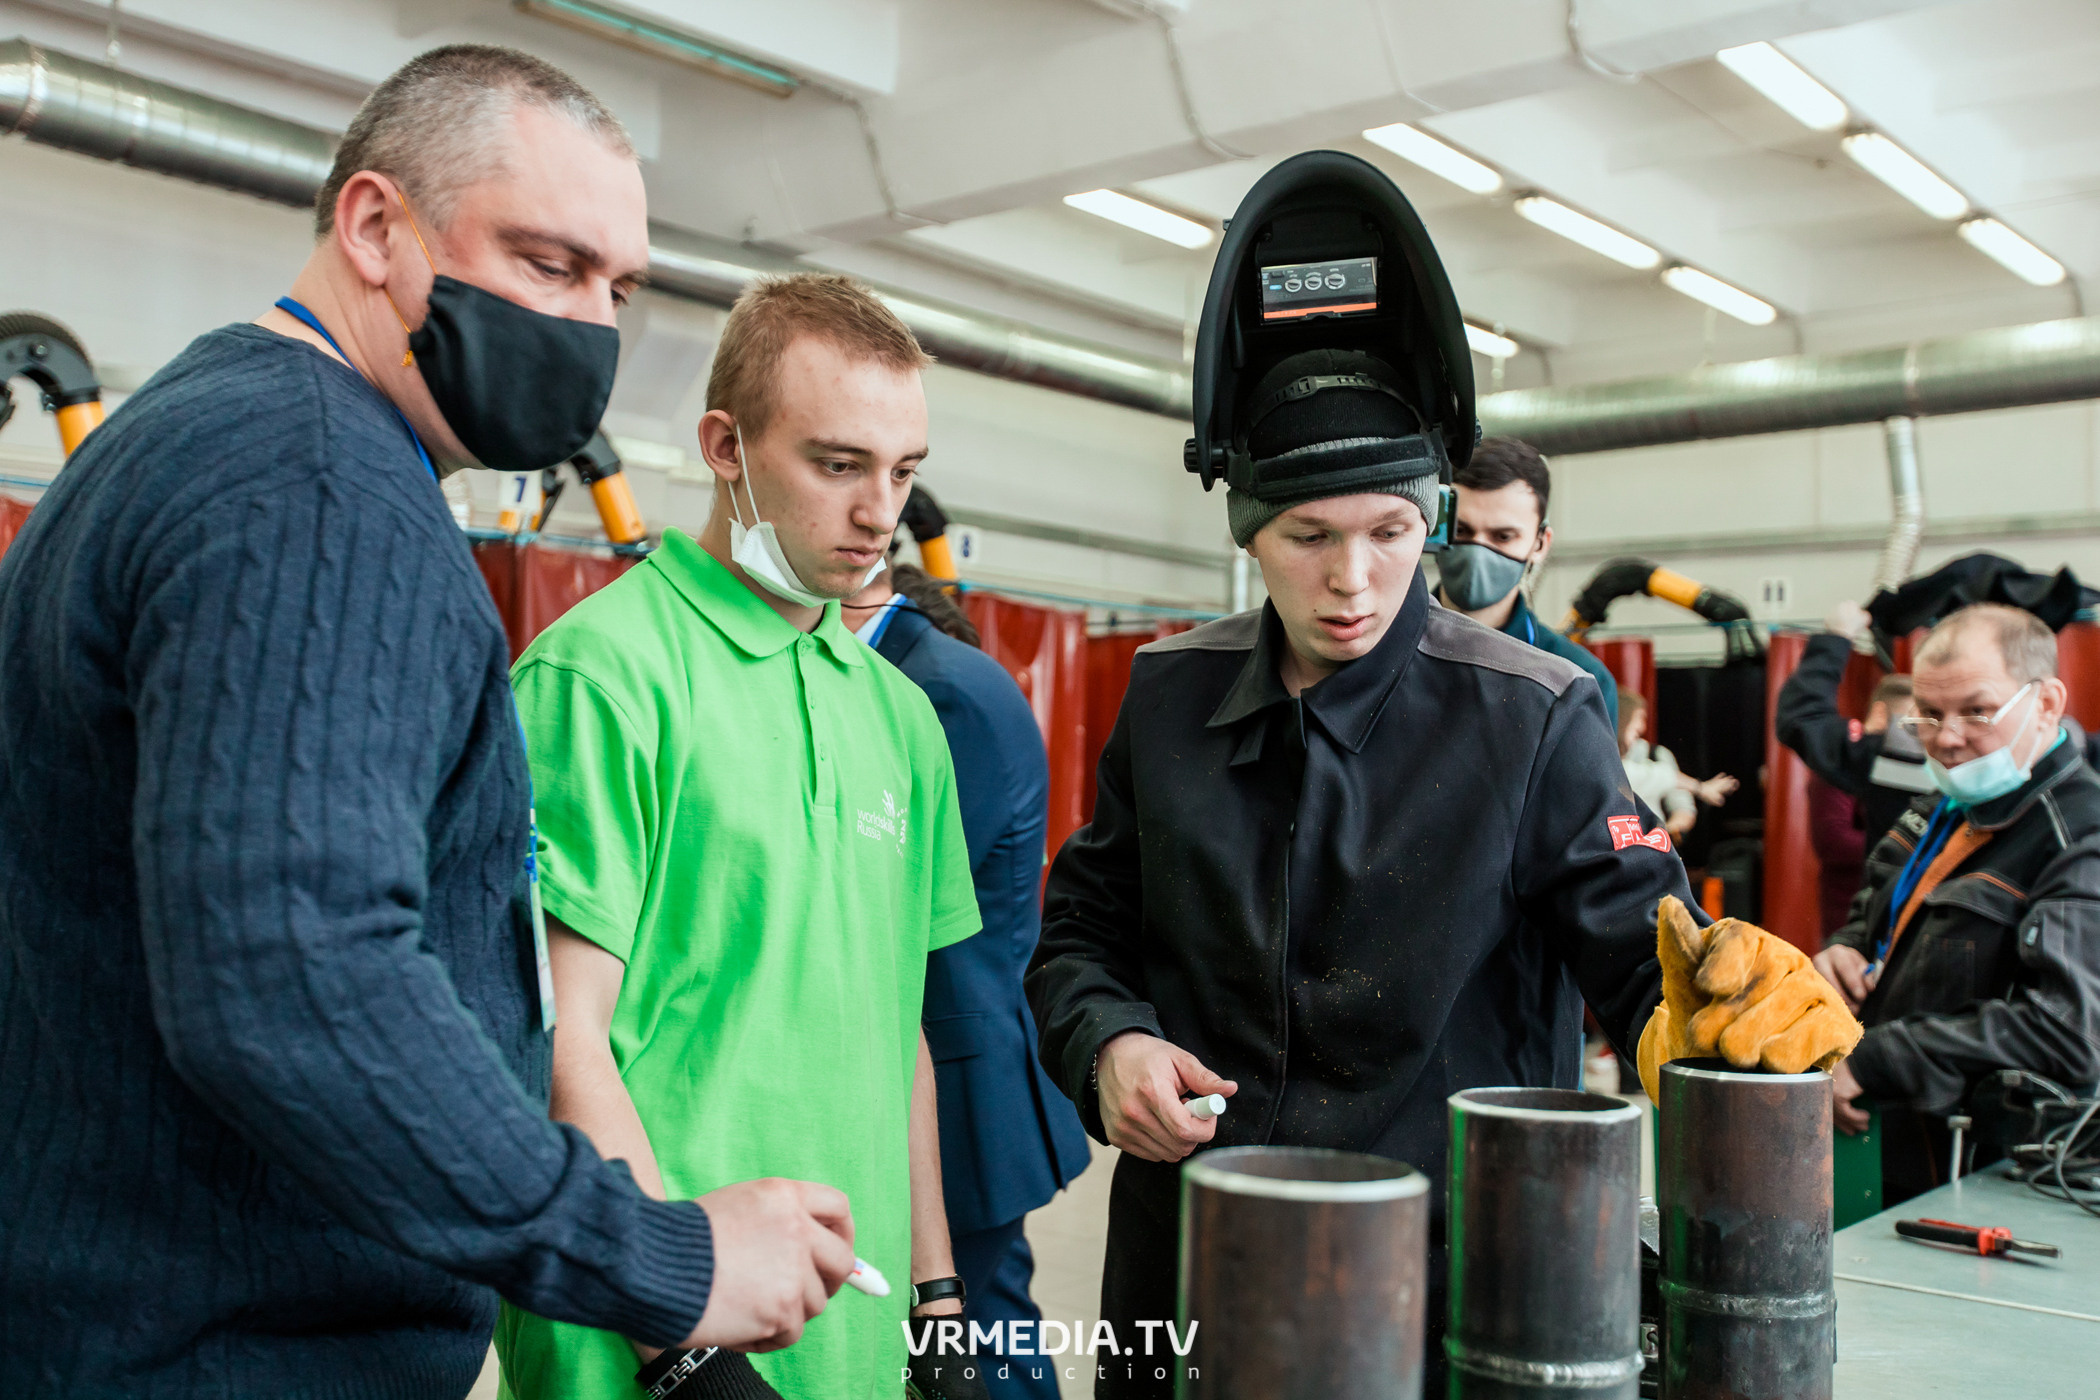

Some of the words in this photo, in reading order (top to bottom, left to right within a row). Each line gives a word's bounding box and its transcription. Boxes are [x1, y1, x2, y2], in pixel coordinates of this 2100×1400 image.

[514, 475, 527, 502] 7
[962, 534, 971, 558] 8
[857, 820, 881, 841] Russia
